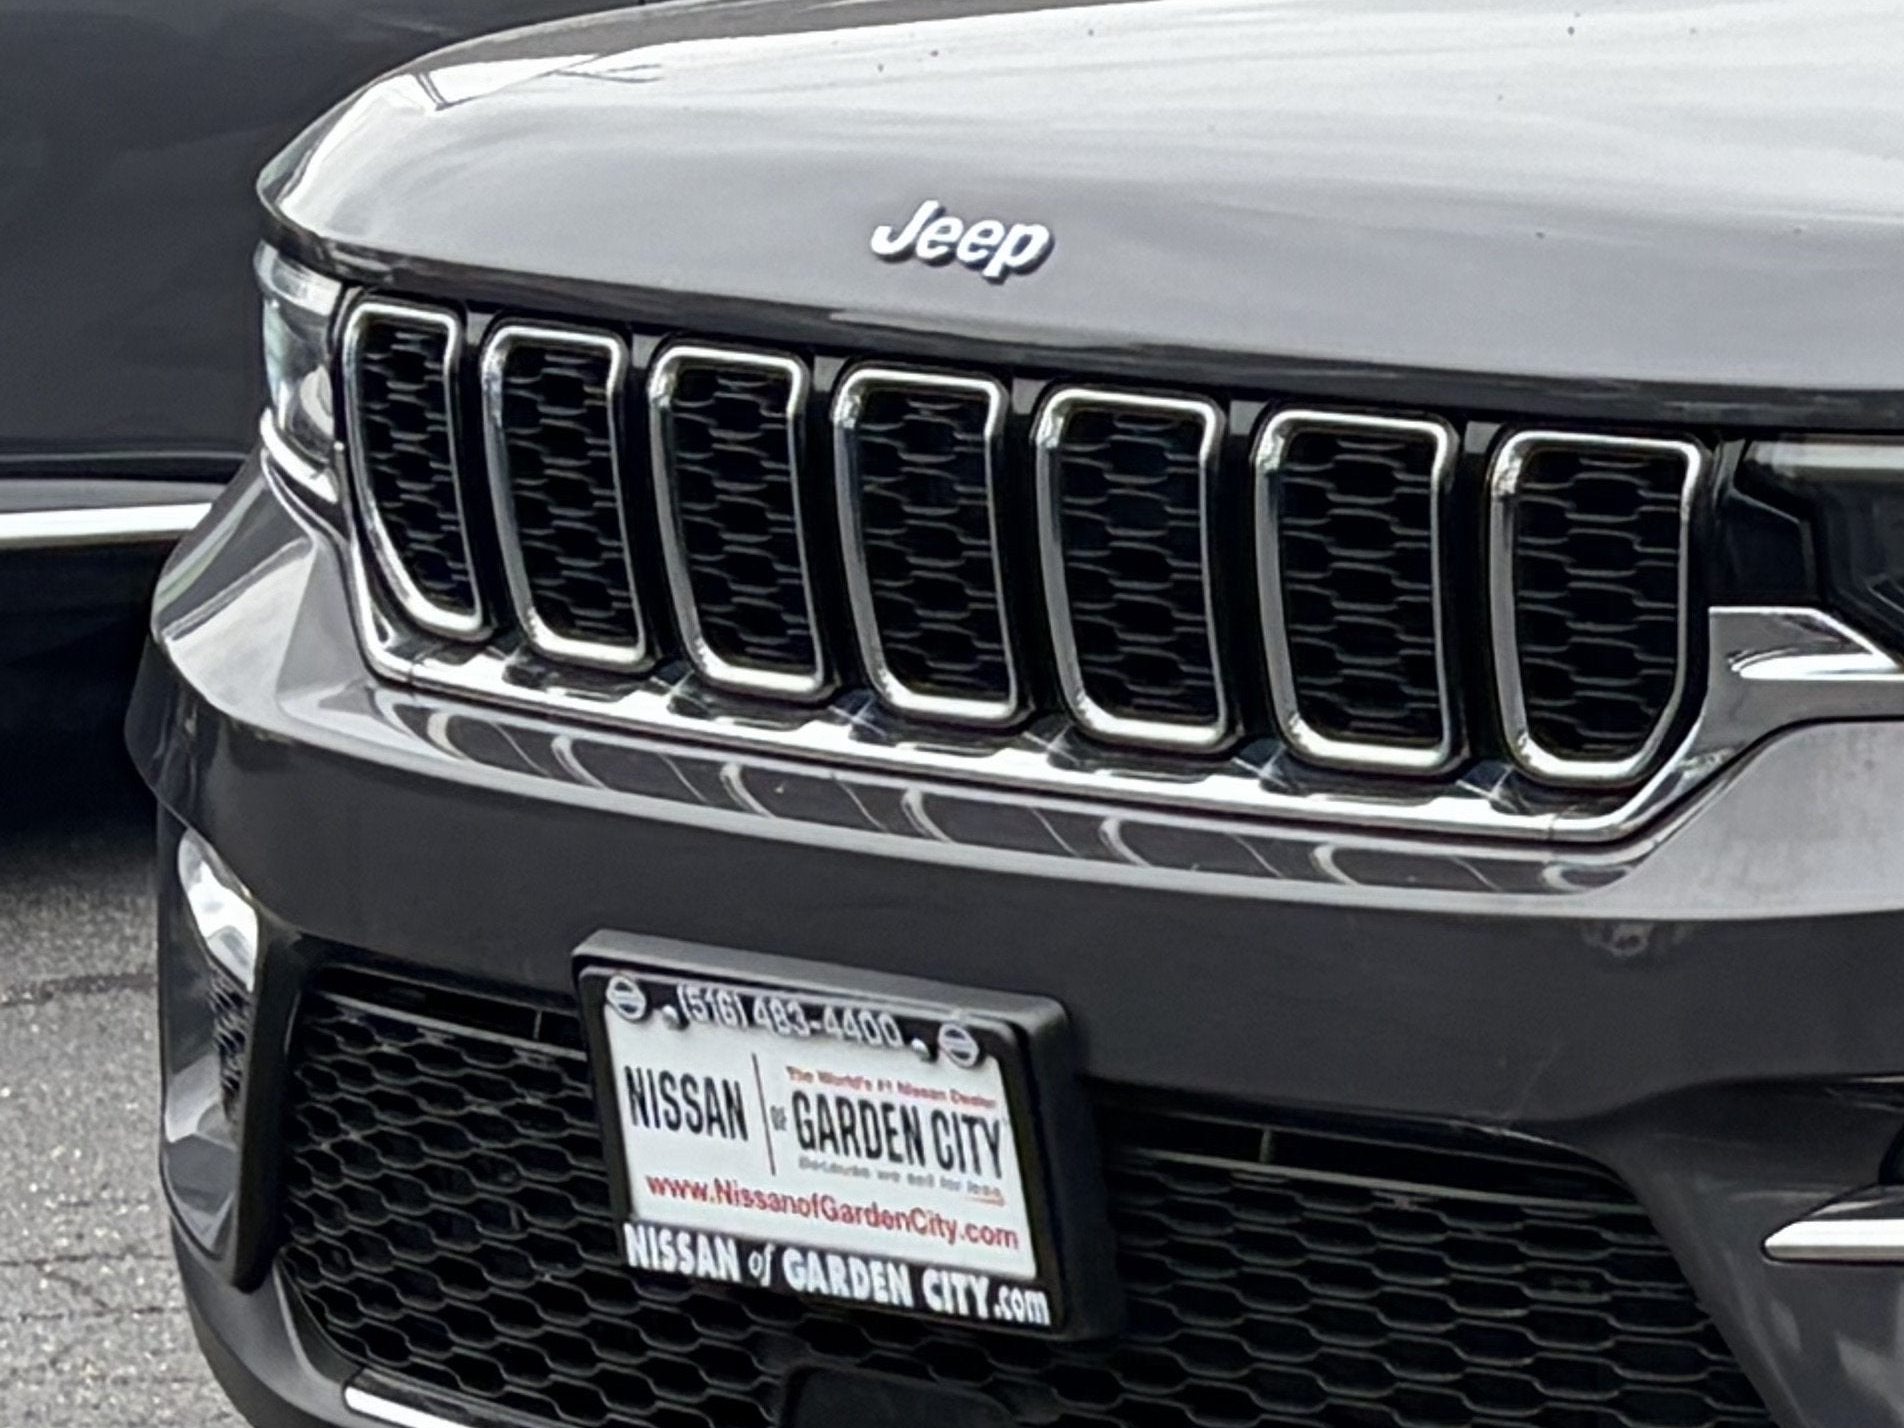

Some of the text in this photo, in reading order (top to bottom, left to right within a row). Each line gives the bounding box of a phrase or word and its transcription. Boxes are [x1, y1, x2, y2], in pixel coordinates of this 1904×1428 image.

[870, 200, 1052, 281] Jeep
[676, 983, 904, 1048] (516) 483-4400
[624, 1066, 748, 1142] NISSAN
[791, 1089, 926, 1168] GARDEN
[931, 1110, 1003, 1179] CITY
[646, 1174, 1020, 1250] www.NissanofGardenCity.com
[623, 1222, 740, 1283] NISSAN
[747, 1244, 775, 1288] of
[782, 1247, 913, 1308] GARDEN
